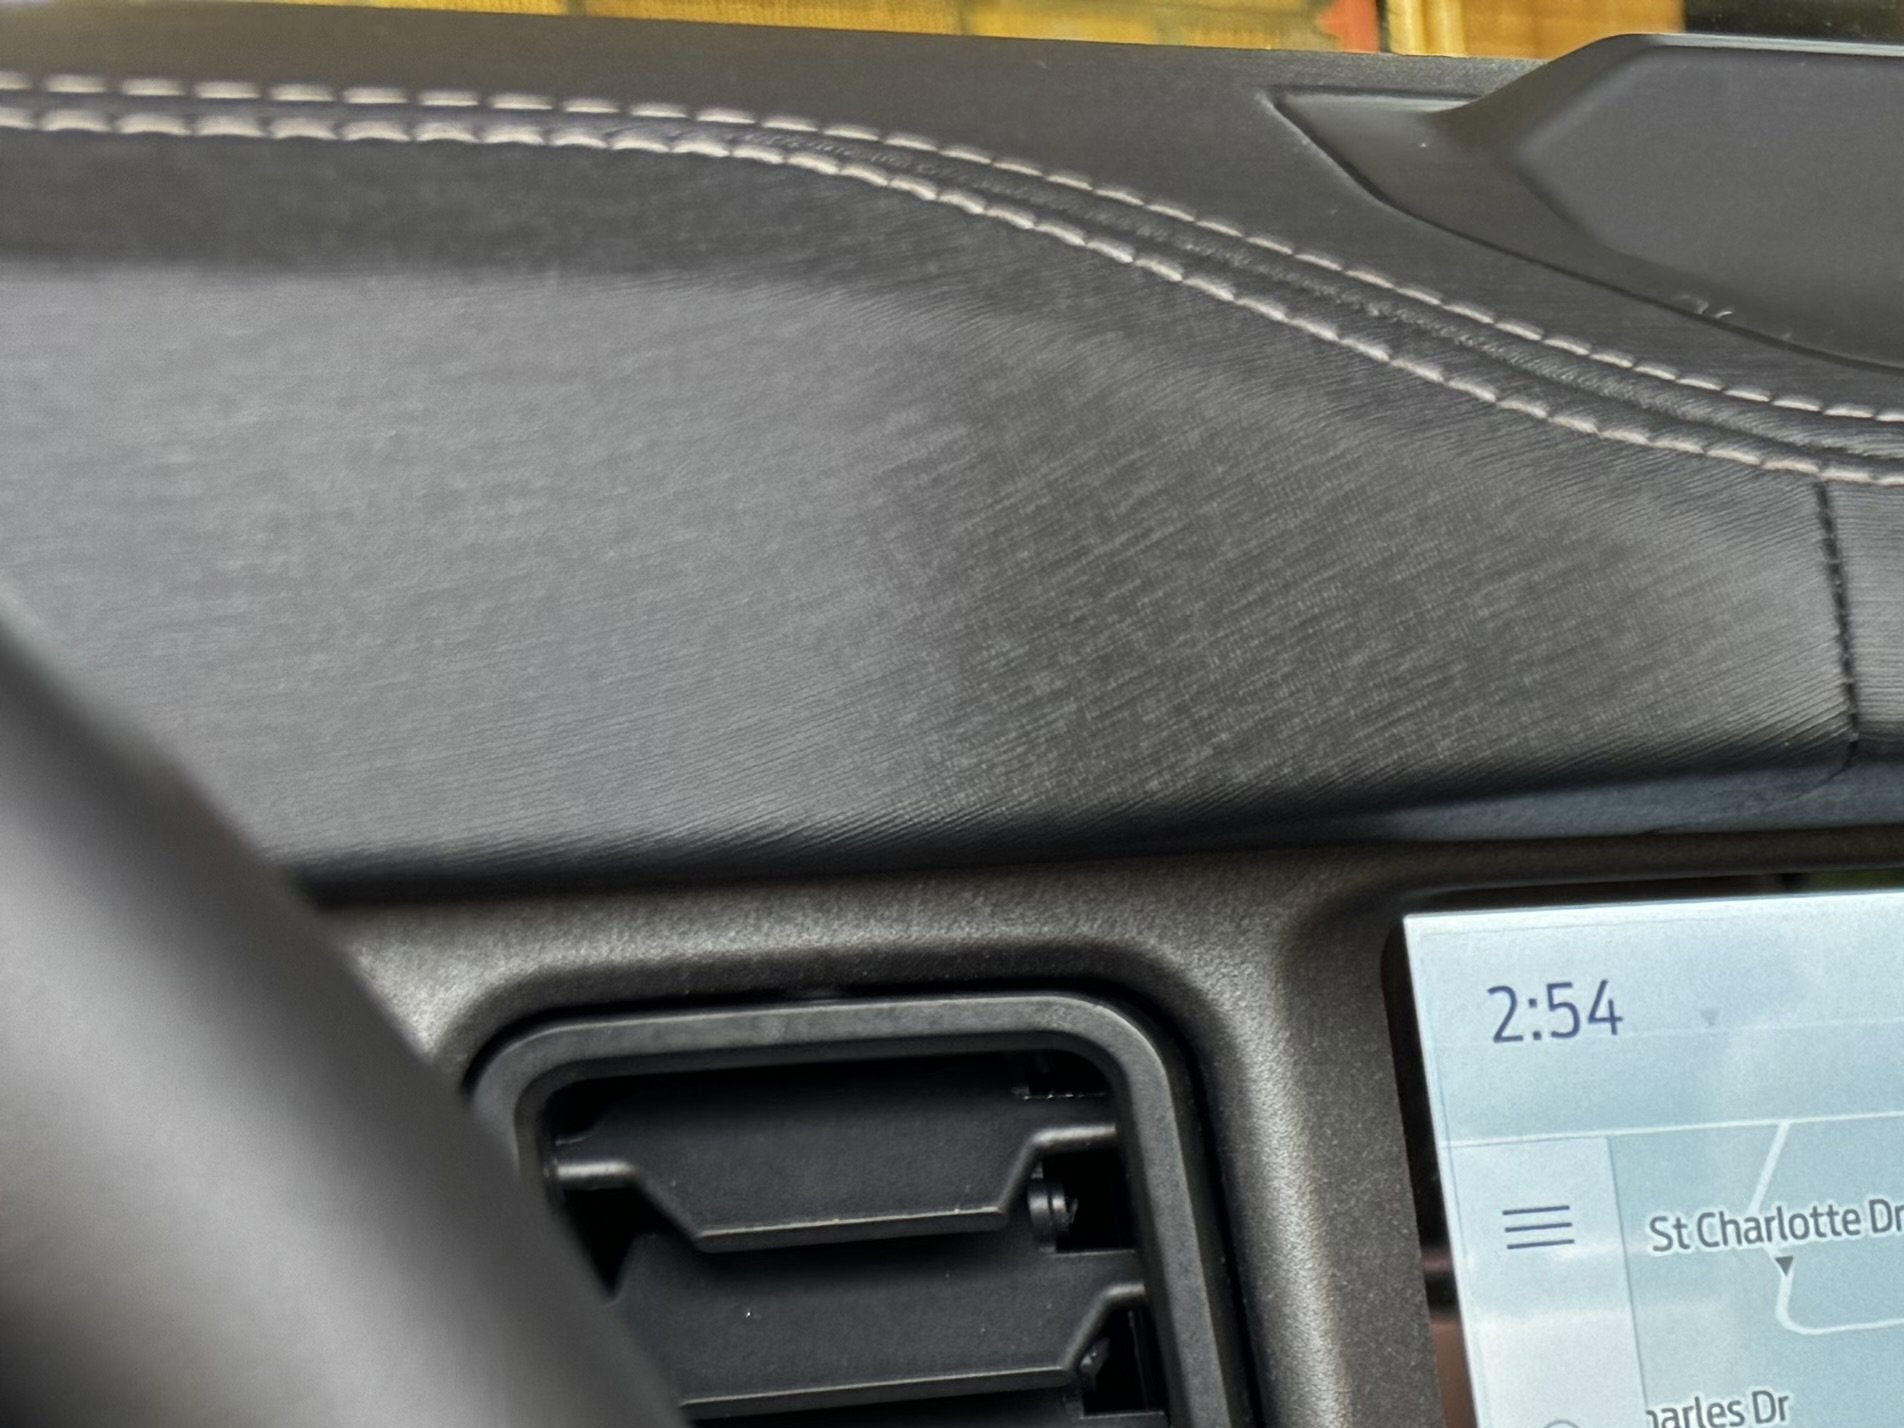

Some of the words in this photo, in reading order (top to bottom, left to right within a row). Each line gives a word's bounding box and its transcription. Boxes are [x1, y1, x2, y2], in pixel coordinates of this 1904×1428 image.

[1487, 979, 1624, 1043] 2:54
[1650, 1215, 1687, 1251] St
[1697, 1204, 1861, 1247] Charlotte
[1752, 1390, 1789, 1424] Dr
